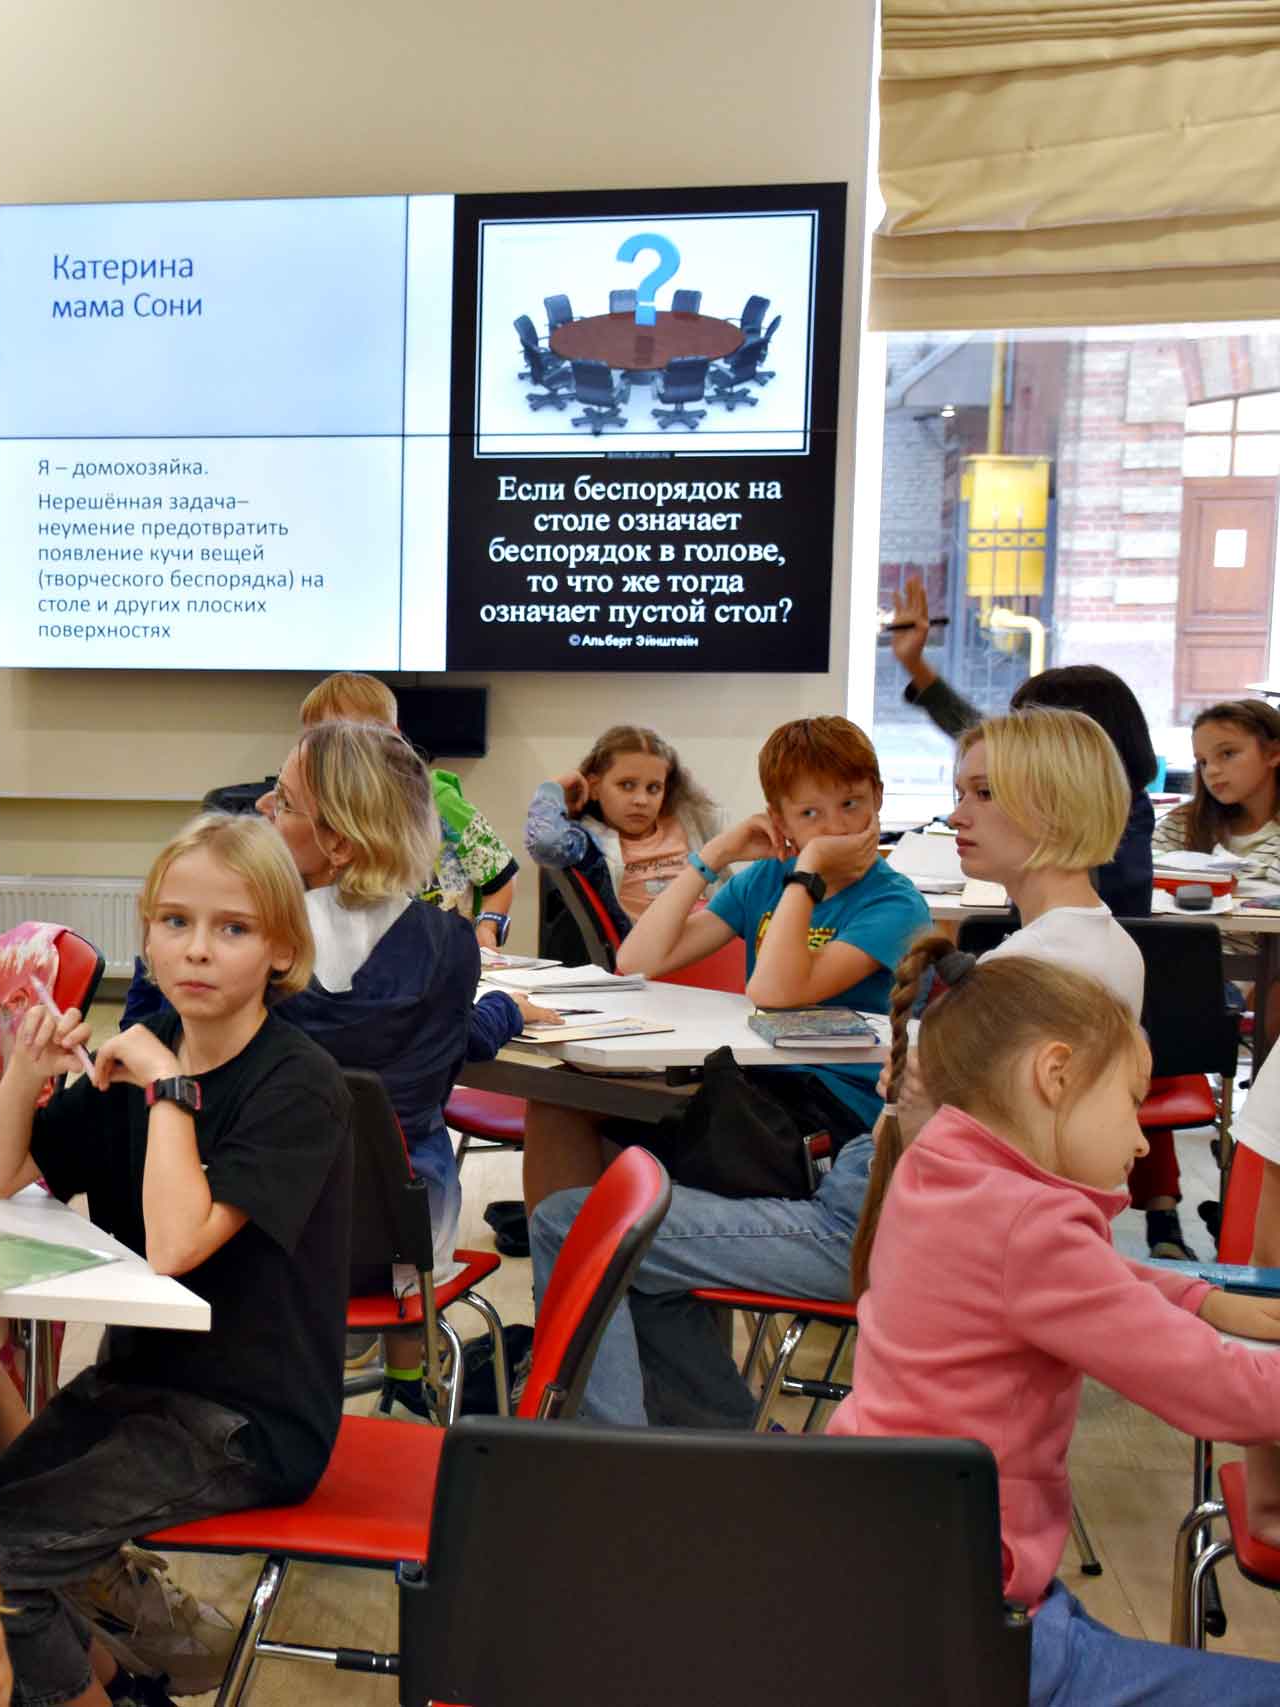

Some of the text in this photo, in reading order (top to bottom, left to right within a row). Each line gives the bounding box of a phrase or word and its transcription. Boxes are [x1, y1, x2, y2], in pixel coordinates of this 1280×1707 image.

[53, 254, 194, 286] Катерина
[52, 292, 203, 319] мама Сони
[38, 459, 49, 476] Я
[72, 458, 210, 479] домохозяйка.
[497, 474, 783, 507] Если беспорядок на
[38, 492, 163, 513] Нерешённая
[38, 522, 290, 540] неумение предотвратить
[533, 511, 743, 532] столе означает
[38, 544, 265, 565] появление кучи вещей
[487, 536, 787, 569] беспорядок в голове,
[37, 568, 325, 591] (творческого беспорядка) на
[526, 573, 746, 596] то что же тогда
[38, 599, 267, 617] столе и других плоских
[479, 598, 793, 629] означает пустой стол?
[38, 624, 172, 642] поверхностях
[635, 633, 700, 648] Эйнштейн
